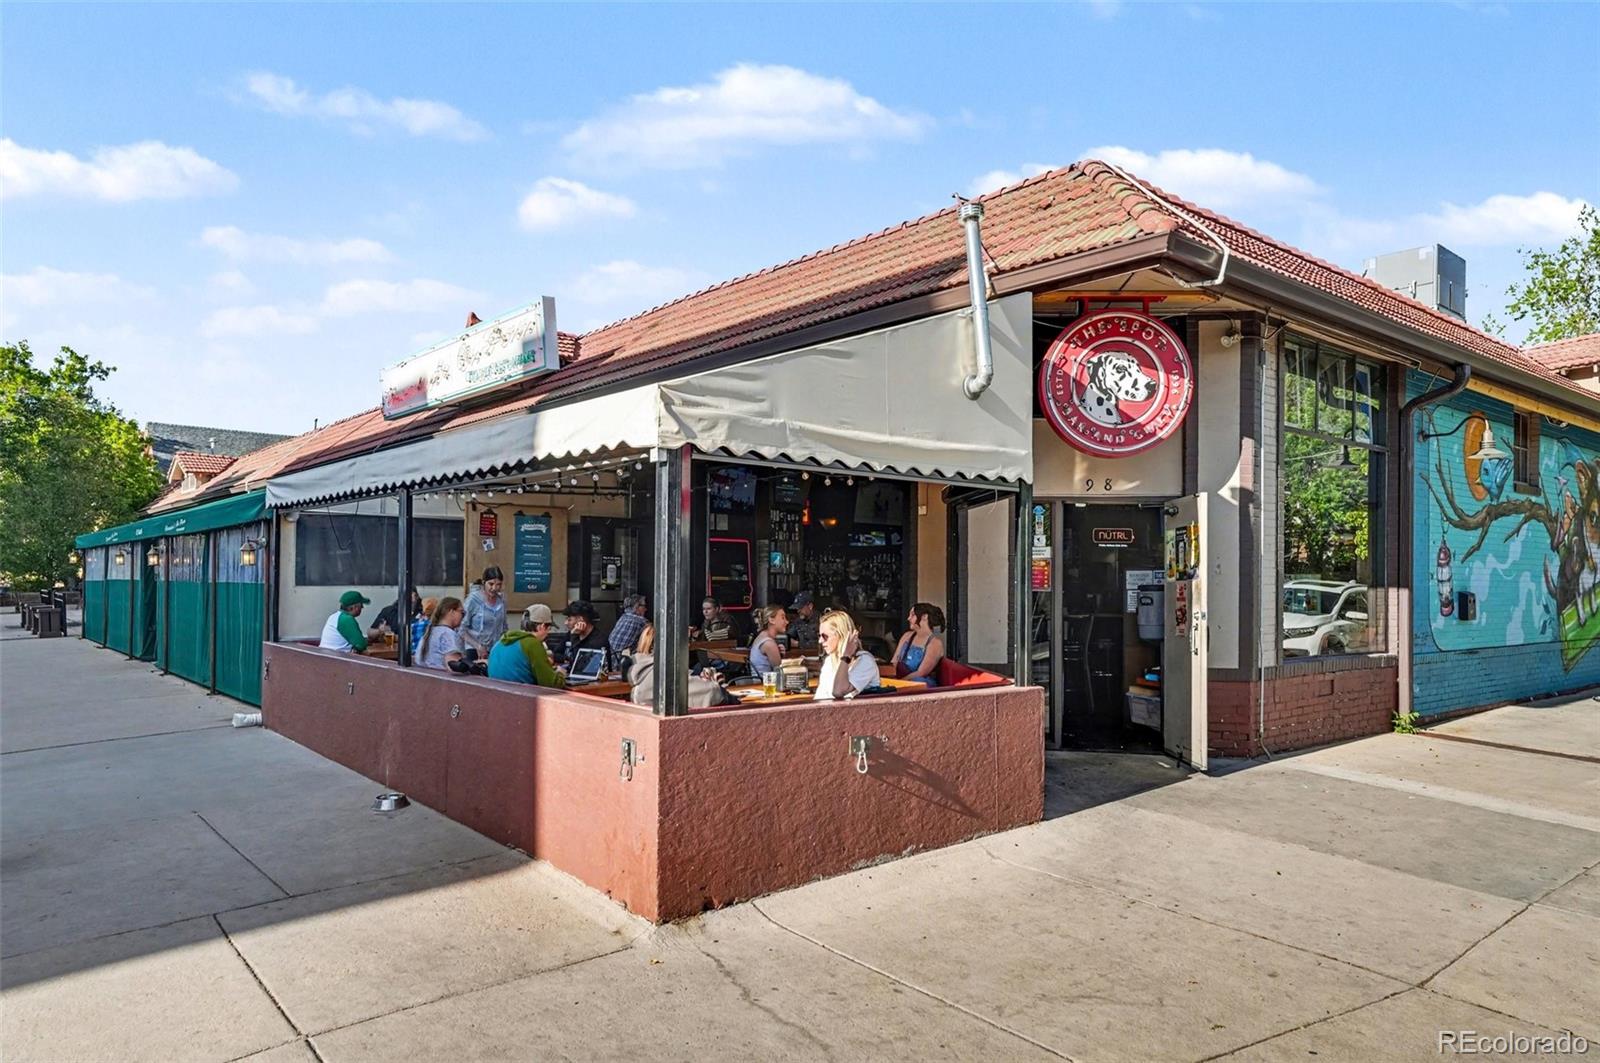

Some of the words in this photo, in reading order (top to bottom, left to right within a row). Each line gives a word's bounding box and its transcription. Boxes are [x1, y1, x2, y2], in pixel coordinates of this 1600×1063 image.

[1072, 321, 1107, 347] THE
[1119, 319, 1168, 348] SPOT
[1062, 404, 1087, 433] BAR
[1091, 431, 1125, 443] AND
